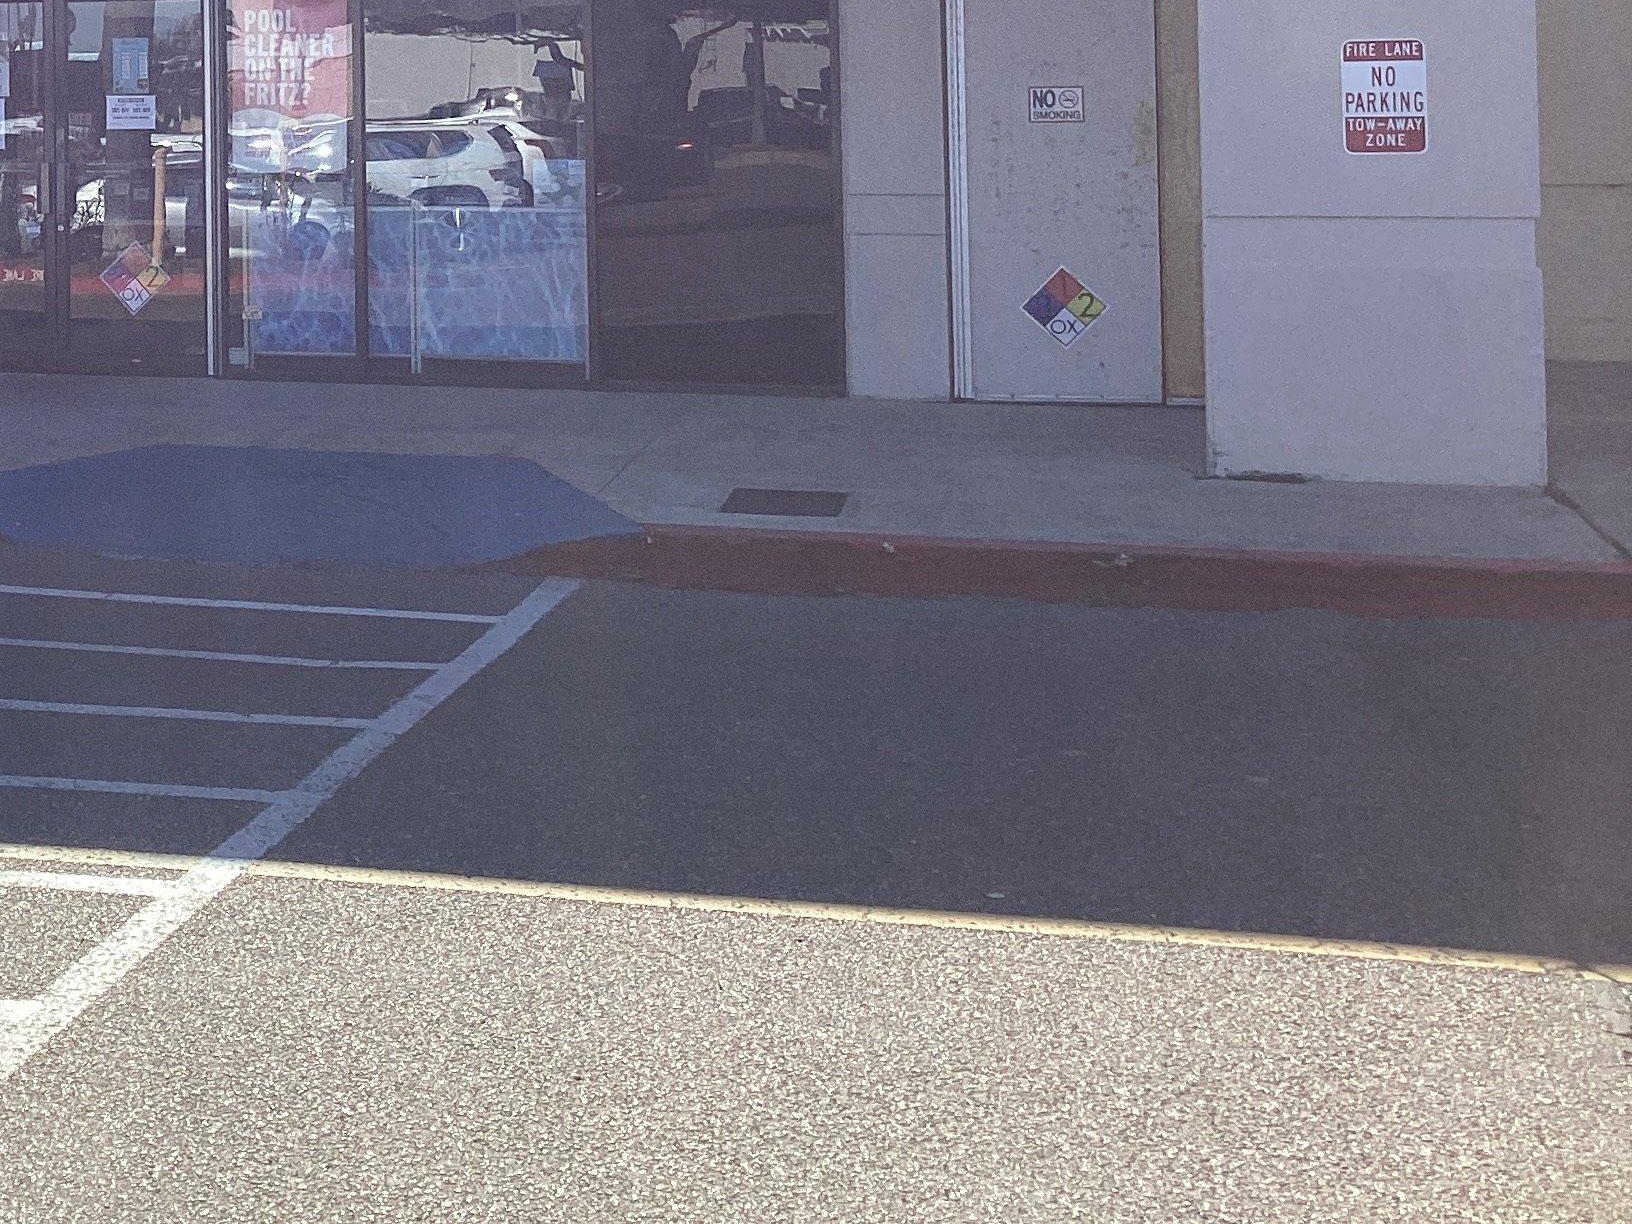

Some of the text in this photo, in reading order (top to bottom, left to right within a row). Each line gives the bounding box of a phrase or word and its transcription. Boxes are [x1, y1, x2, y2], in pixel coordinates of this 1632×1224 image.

[244, 8, 296, 33] POOL
[244, 33, 334, 57] CLEANER
[1346, 41, 1420, 57] FIRE LANE
[244, 56, 315, 81] ON THE
[1371, 65, 1396, 87] NO
[244, 81, 311, 106] FRITZ?
[1032, 89, 1055, 109] NO
[1345, 91, 1424, 113] PARKING
[1033, 110, 1081, 120] SMOKING
[1347, 118, 1423, 131] TOW-AWAY
[1366, 133, 1407, 147] ZONE
[145, 266, 160, 287] 2
[122, 287, 143, 301] OX
[1078, 292, 1101, 317] 2
[1050, 319, 1078, 334] OX
